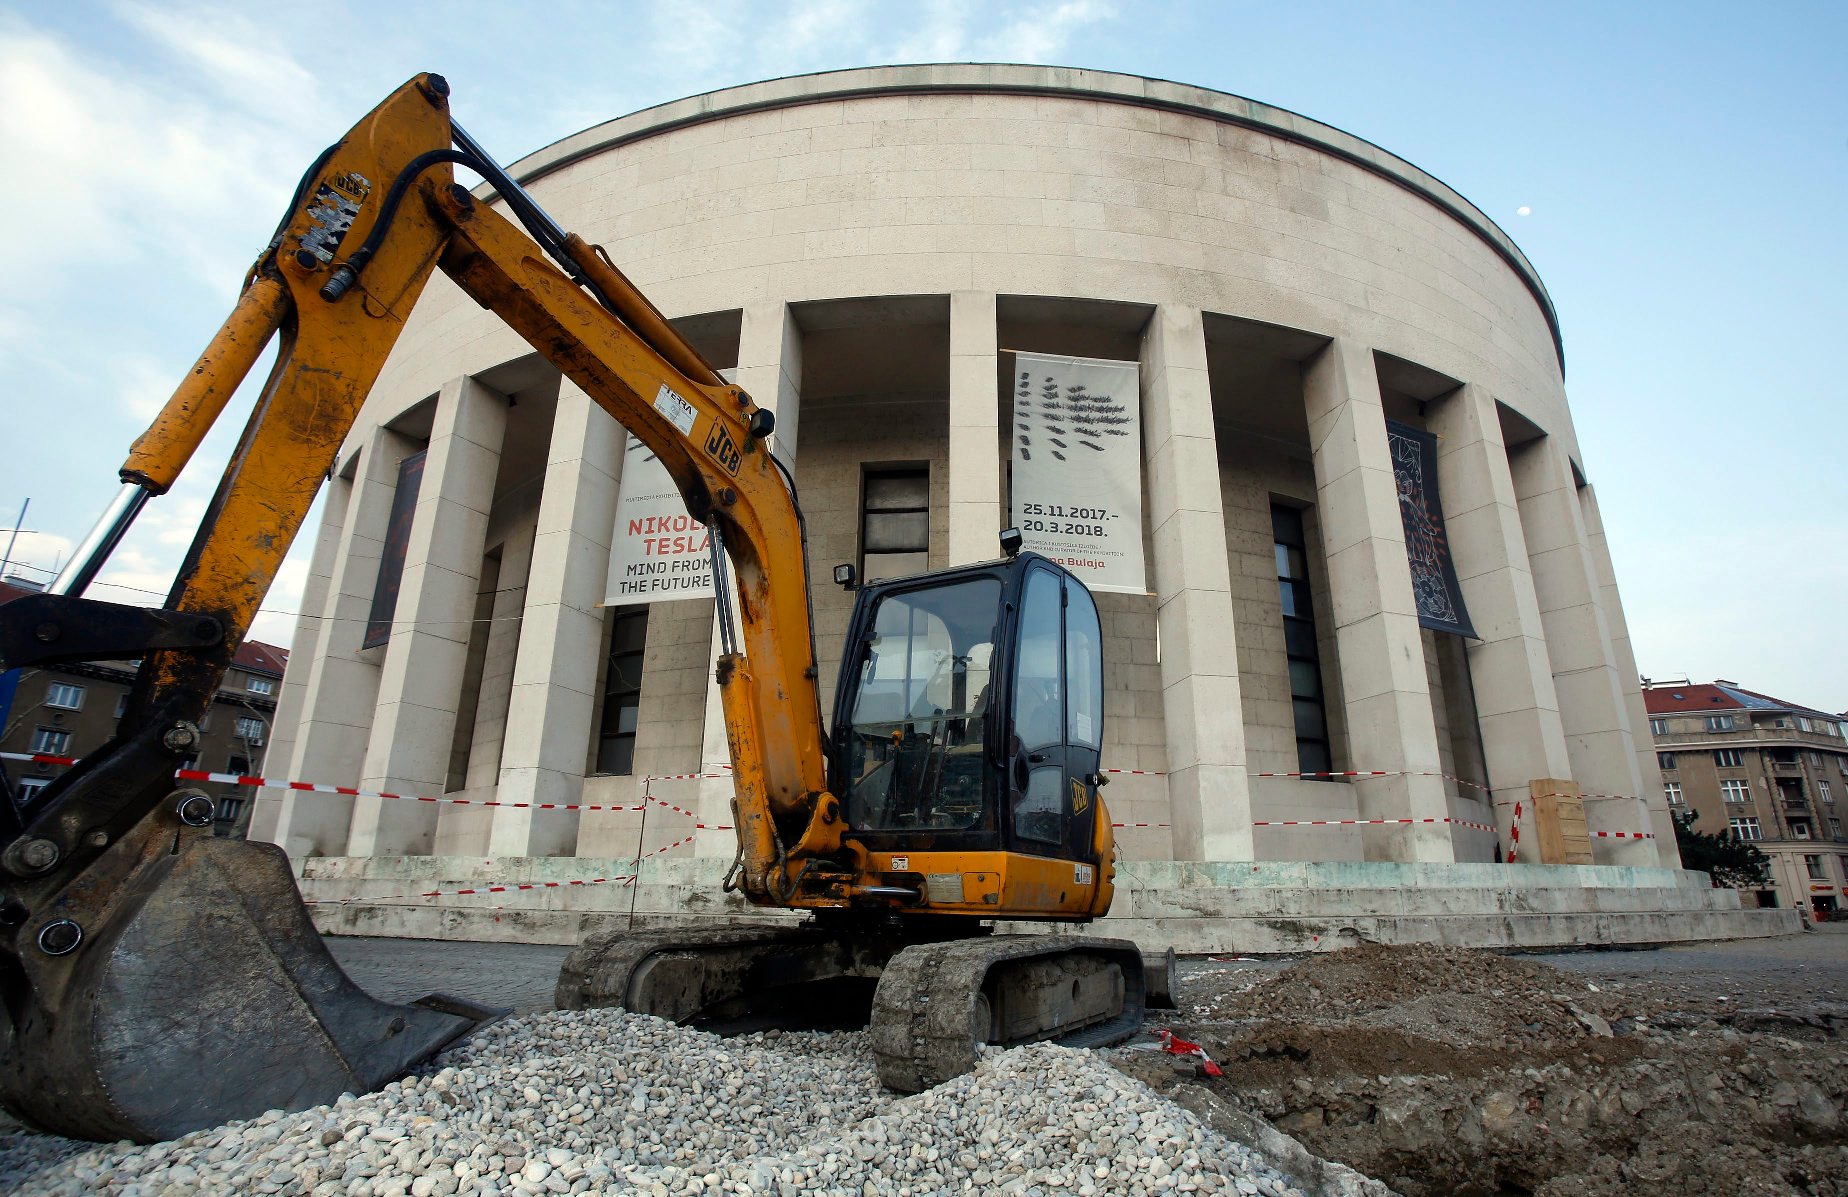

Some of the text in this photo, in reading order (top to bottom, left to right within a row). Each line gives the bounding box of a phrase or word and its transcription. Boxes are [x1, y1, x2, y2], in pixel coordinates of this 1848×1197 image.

[708, 425, 740, 472] JCB
[656, 492, 682, 500] EXHIBITI
[628, 515, 707, 536] NIKOL
[1023, 520, 1108, 537] 20.3.2018.
[643, 534, 711, 556] TESLA
[626, 558, 712, 577] MIND FROM
[1067, 557, 1105, 570] Bulaja
[619, 574, 711, 594] THE FUTURE
[1072, 781, 1088, 811] JCB
